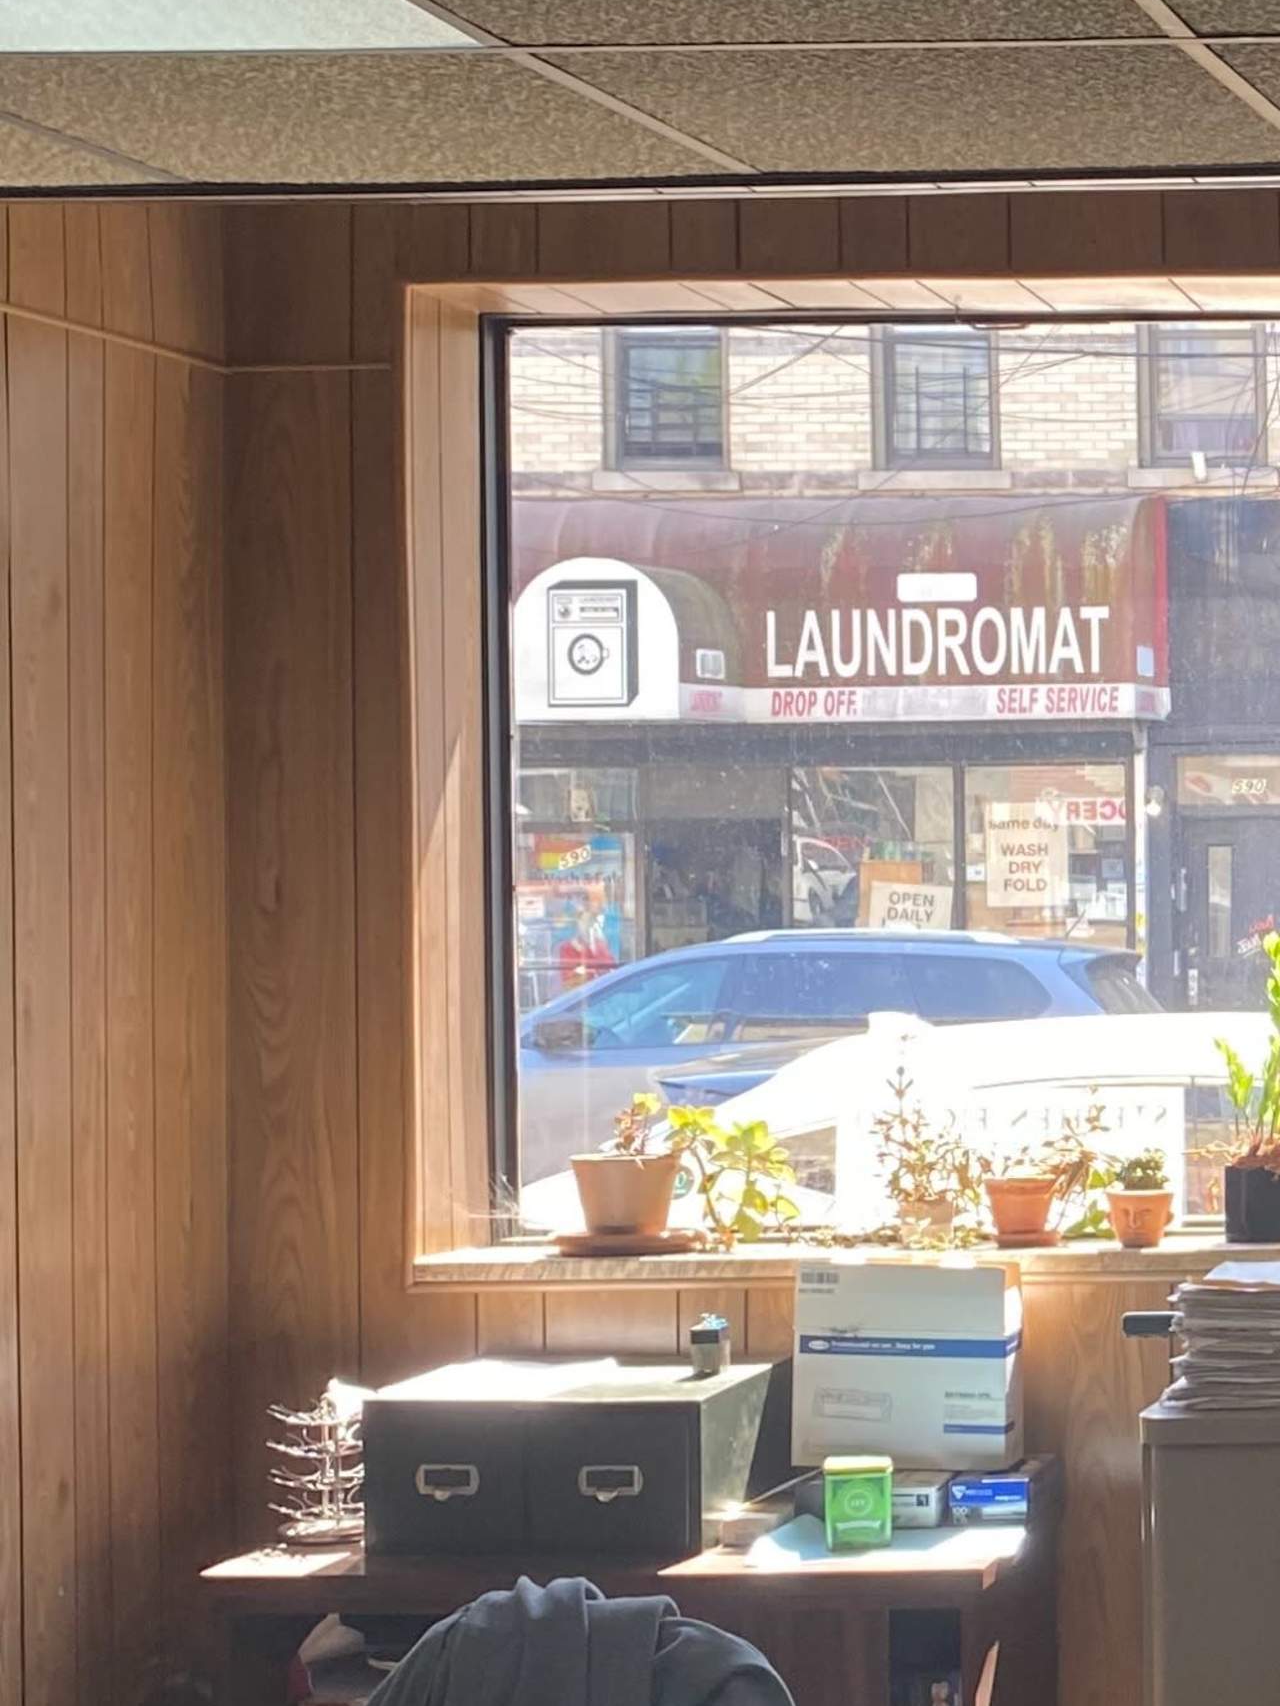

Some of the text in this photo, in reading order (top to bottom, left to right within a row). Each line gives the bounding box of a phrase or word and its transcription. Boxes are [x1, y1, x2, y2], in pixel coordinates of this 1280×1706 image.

[766, 606, 1109, 678] LAUNDROMAT
[771, 691, 817, 717] DROP
[997, 688, 1038, 714] SELF
[1046, 686, 1120, 714] SERVICE
[1232, 779, 1267, 794] 590
[1001, 843, 1048, 856] WASH
[560, 847, 590, 869] 590
[1008, 861, 1041, 874] DRY
[1003, 878, 1048, 892] FOLD
[889, 891, 935, 907] OPEN
[887, 906, 933, 923] DAILY
